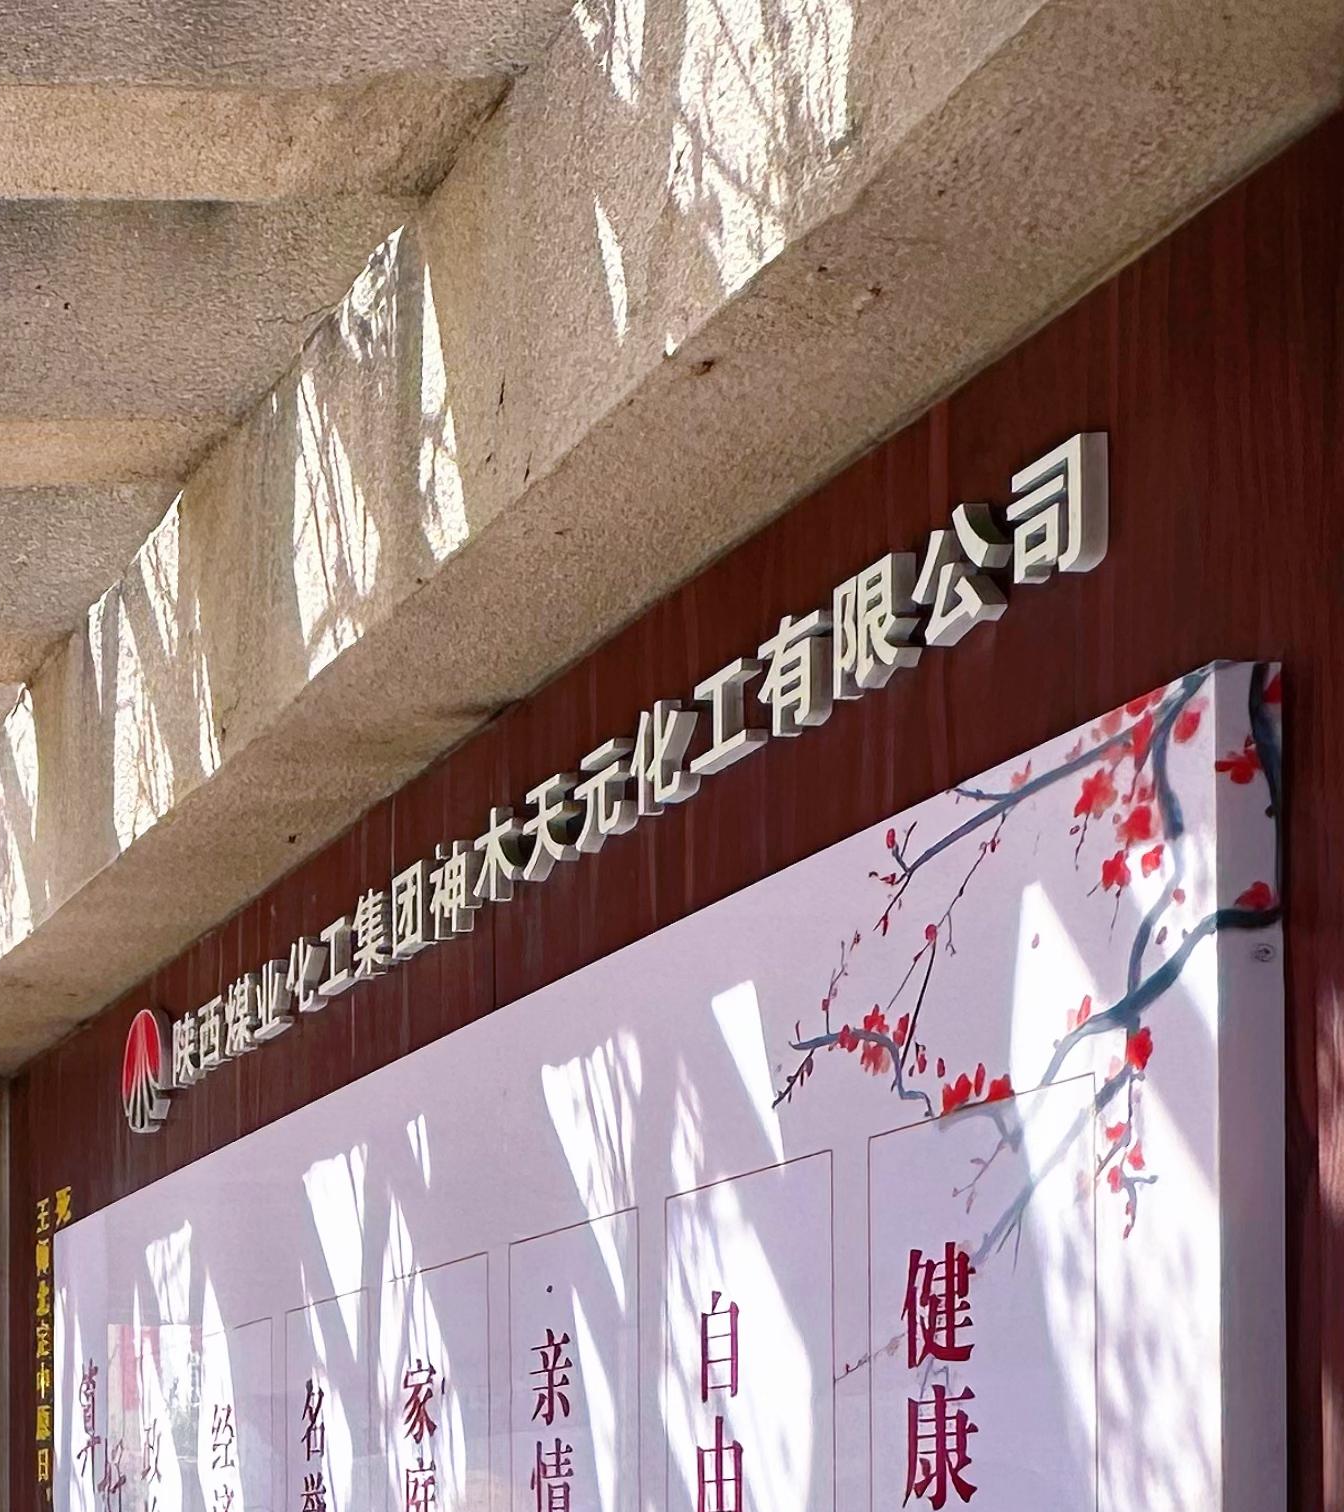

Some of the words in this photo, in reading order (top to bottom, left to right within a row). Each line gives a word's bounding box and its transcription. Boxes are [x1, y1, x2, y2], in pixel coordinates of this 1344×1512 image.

[170, 431, 1109, 1090] 陕西煤业化工集团神木天元化工有限公司
